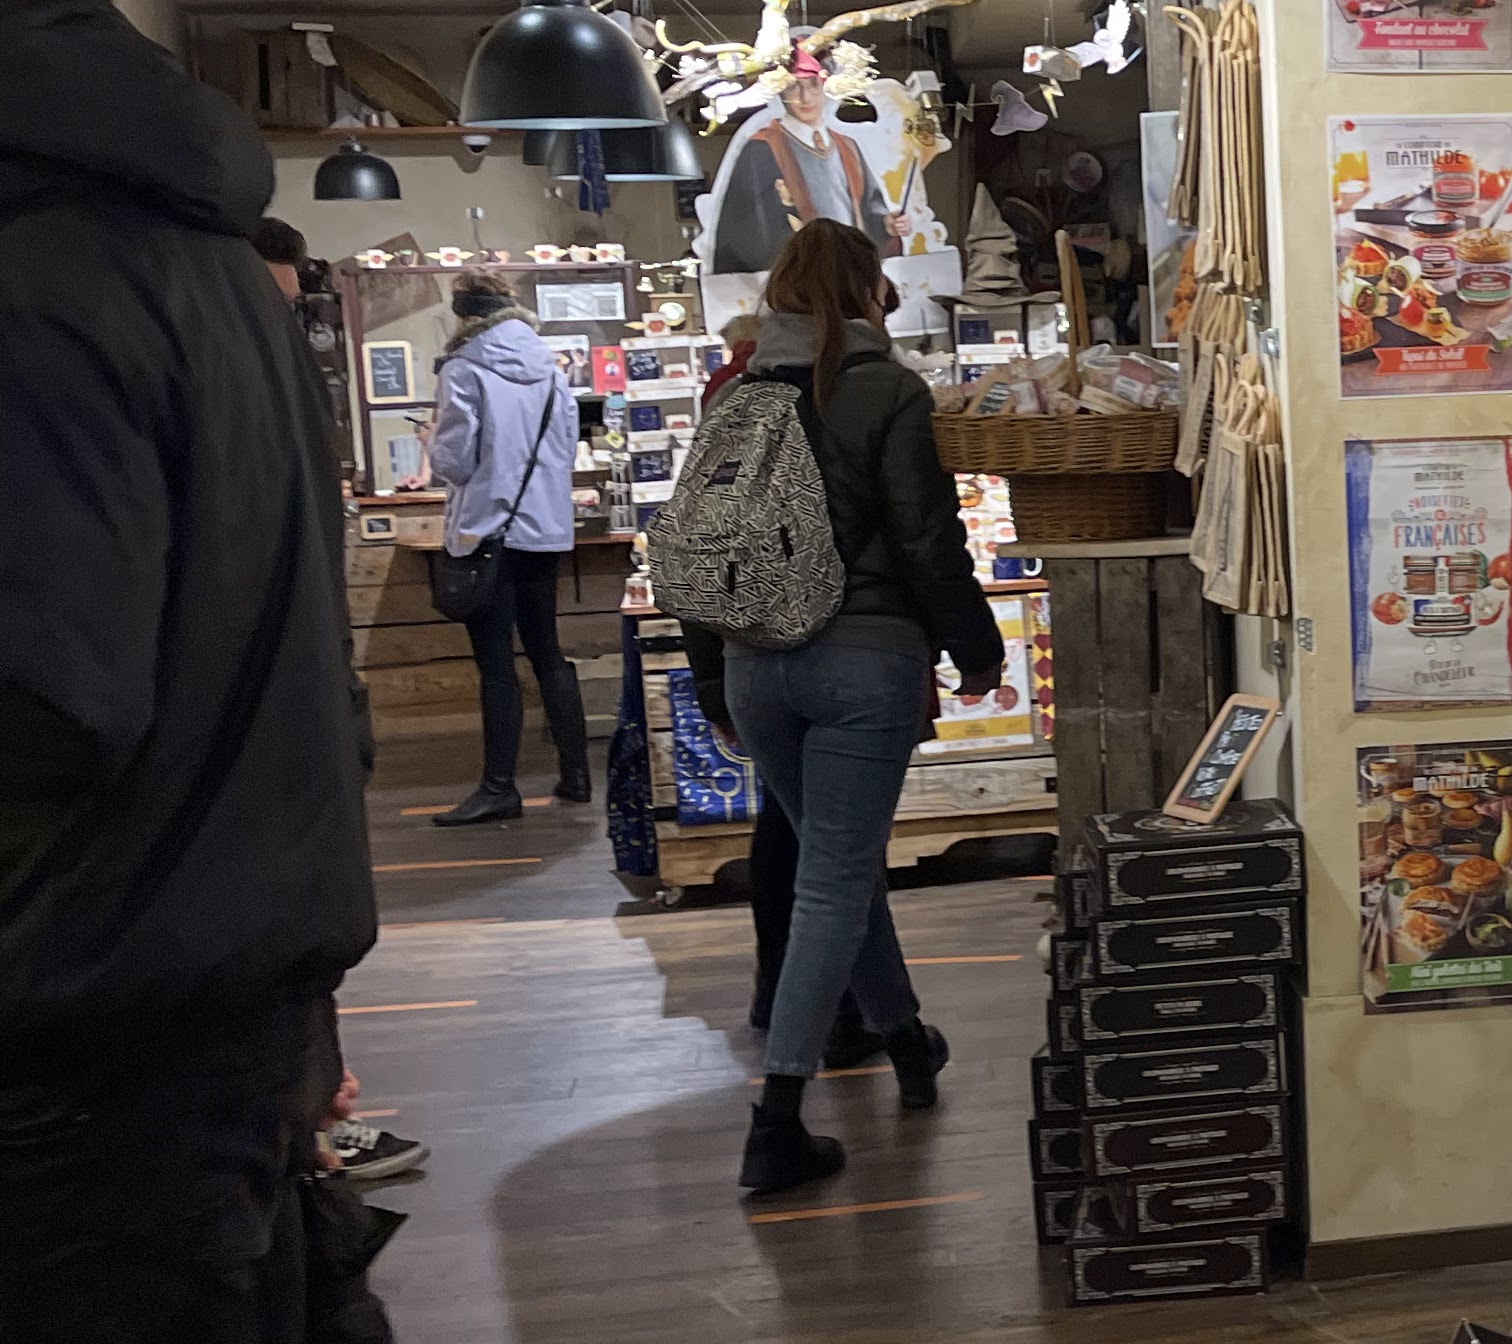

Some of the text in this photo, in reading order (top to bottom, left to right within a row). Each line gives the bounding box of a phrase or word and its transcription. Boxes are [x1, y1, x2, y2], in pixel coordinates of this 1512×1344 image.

[1386, 149, 1463, 165] MATHILDE
[1394, 522, 1487, 551] FRANÇAISES
[1413, 773, 1489, 791] MATHILDE
